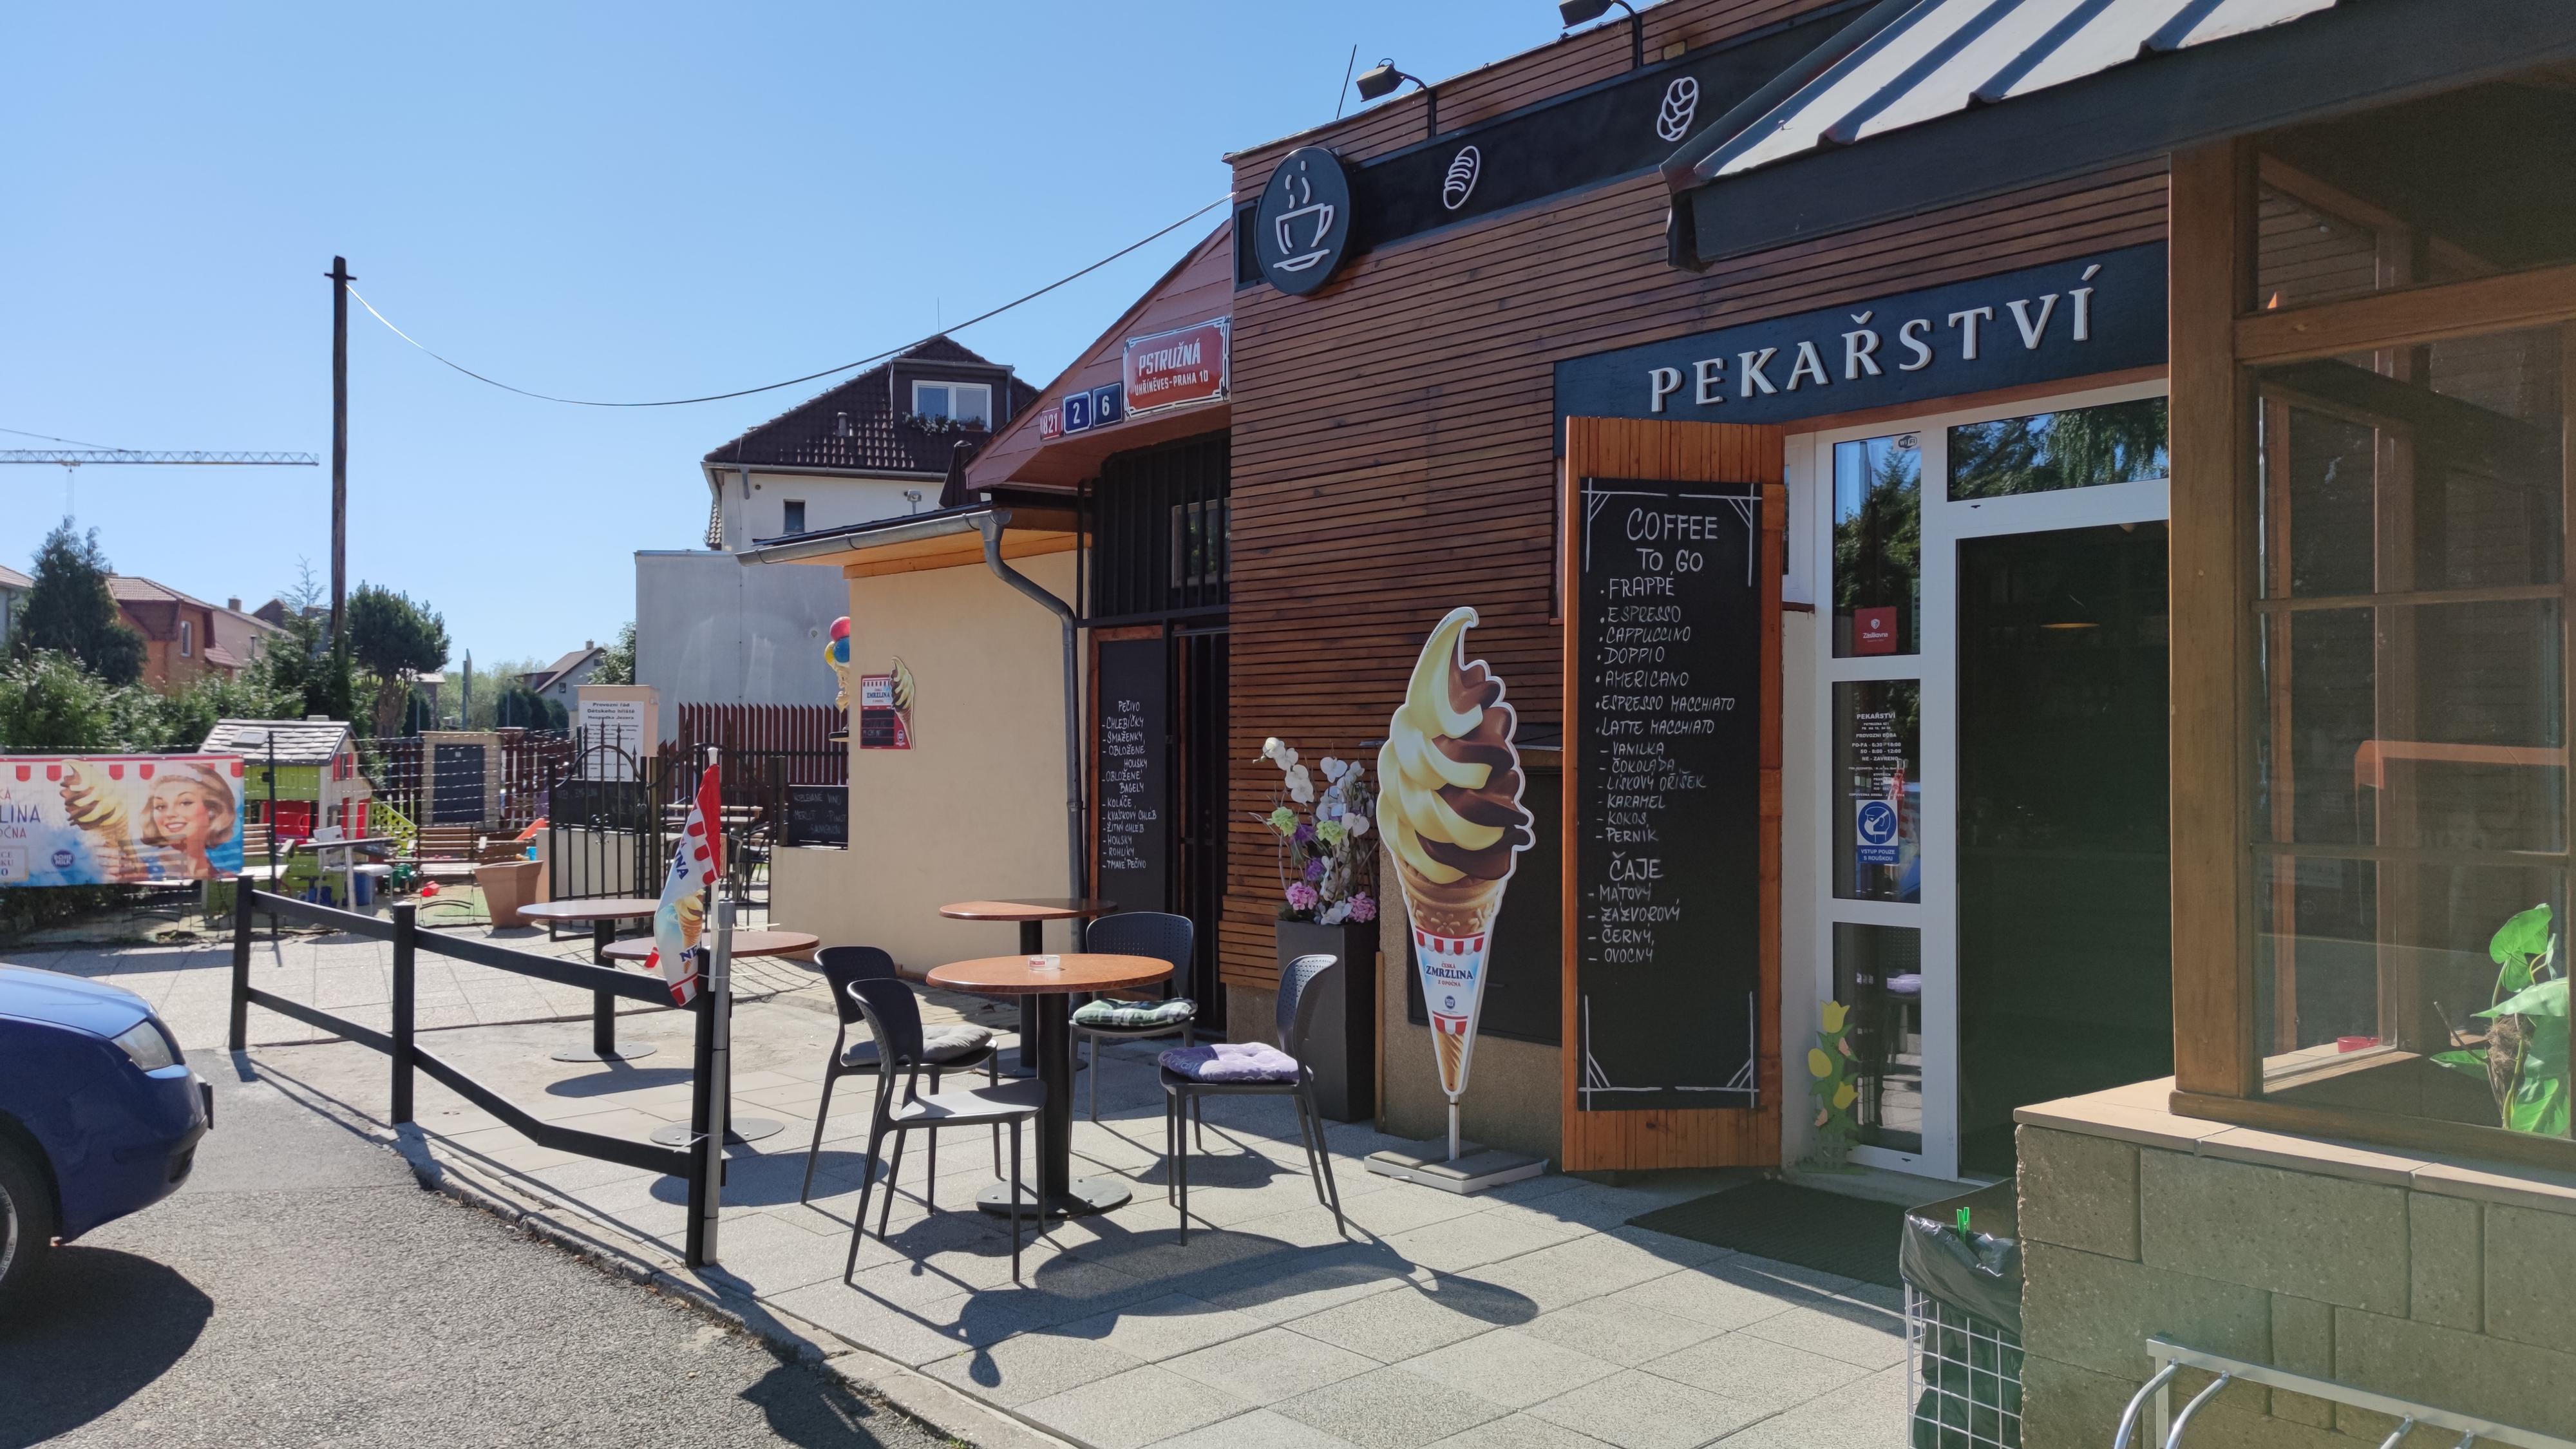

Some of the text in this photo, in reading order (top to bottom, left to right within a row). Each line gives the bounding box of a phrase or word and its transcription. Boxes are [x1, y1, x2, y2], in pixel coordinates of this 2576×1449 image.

[1647, 263, 2102, 413] PEKAŘSTVÍ
[1139, 338, 1201, 376] PSTRUŽNÁ
[1072, 402, 1081, 424] 2
[1101, 394, 1110, 417] 6
[1043, 412, 1058, 435] 821
[1627, 507, 1718, 540] COFFEE
[1636, 548, 1703, 572] TO GO
[1609, 571, 1674, 599] FRAPPÉ
[1607, 605, 1681, 623] ESPRESSO
[1606, 627, 1690, 644] CAPPUCCINO
[1604, 646, 1665, 665] DOPPIO
[1605, 670, 1689, 688] AMERICANO
[1118, 699, 1141, 712] PEČIVO
[1601, 695, 1735, 712] ESPRESSO MACCHIATO
[1106, 713, 1144, 730] CHLEBÍČKY
[1601, 717, 1715, 736] LATTE MACCHIATO
[1107, 730, 1143, 744] SMAŽENKY
[1108, 739, 1146, 756] OBLOŽENÉ
[1613, 741, 1664, 755] VANILKA
[1124, 759, 1148, 768] HOUSKY
[1106, 768, 1142, 782] OBLOŽENÉ
[1607, 768, 1706, 791] LÍSKOVÝ OŘÍŠEK
[1119, 782, 1144, 794] BAGELY
[1108, 795, 1132, 808] KOLÁČE
[1607, 793, 1666, 809] KARAMEL
[1108, 805, 1157, 821] KVÁSKOVÝ CHLÉB
[1608, 811, 1646, 825] KOKOS
[1107, 820, 1124, 833] ŽITNÝ
[1605, 824, 1659, 842] PERNÍK
[1108, 835, 1132, 846] HOUSKY
[1108, 845, 1134, 857] ROHLÍKY
[1107, 857, 1147, 869] TMAVÉ PEČIVO
[1610, 851, 1664, 881] ČAJE
[1600, 882, 1651, 902] MÁTOVÝ
[1602, 923, 1651, 944] ČERNÝ
[1604, 940, 1653, 963] OVOCNÝ
[1426, 965, 1473, 980] ZMRZLINA
